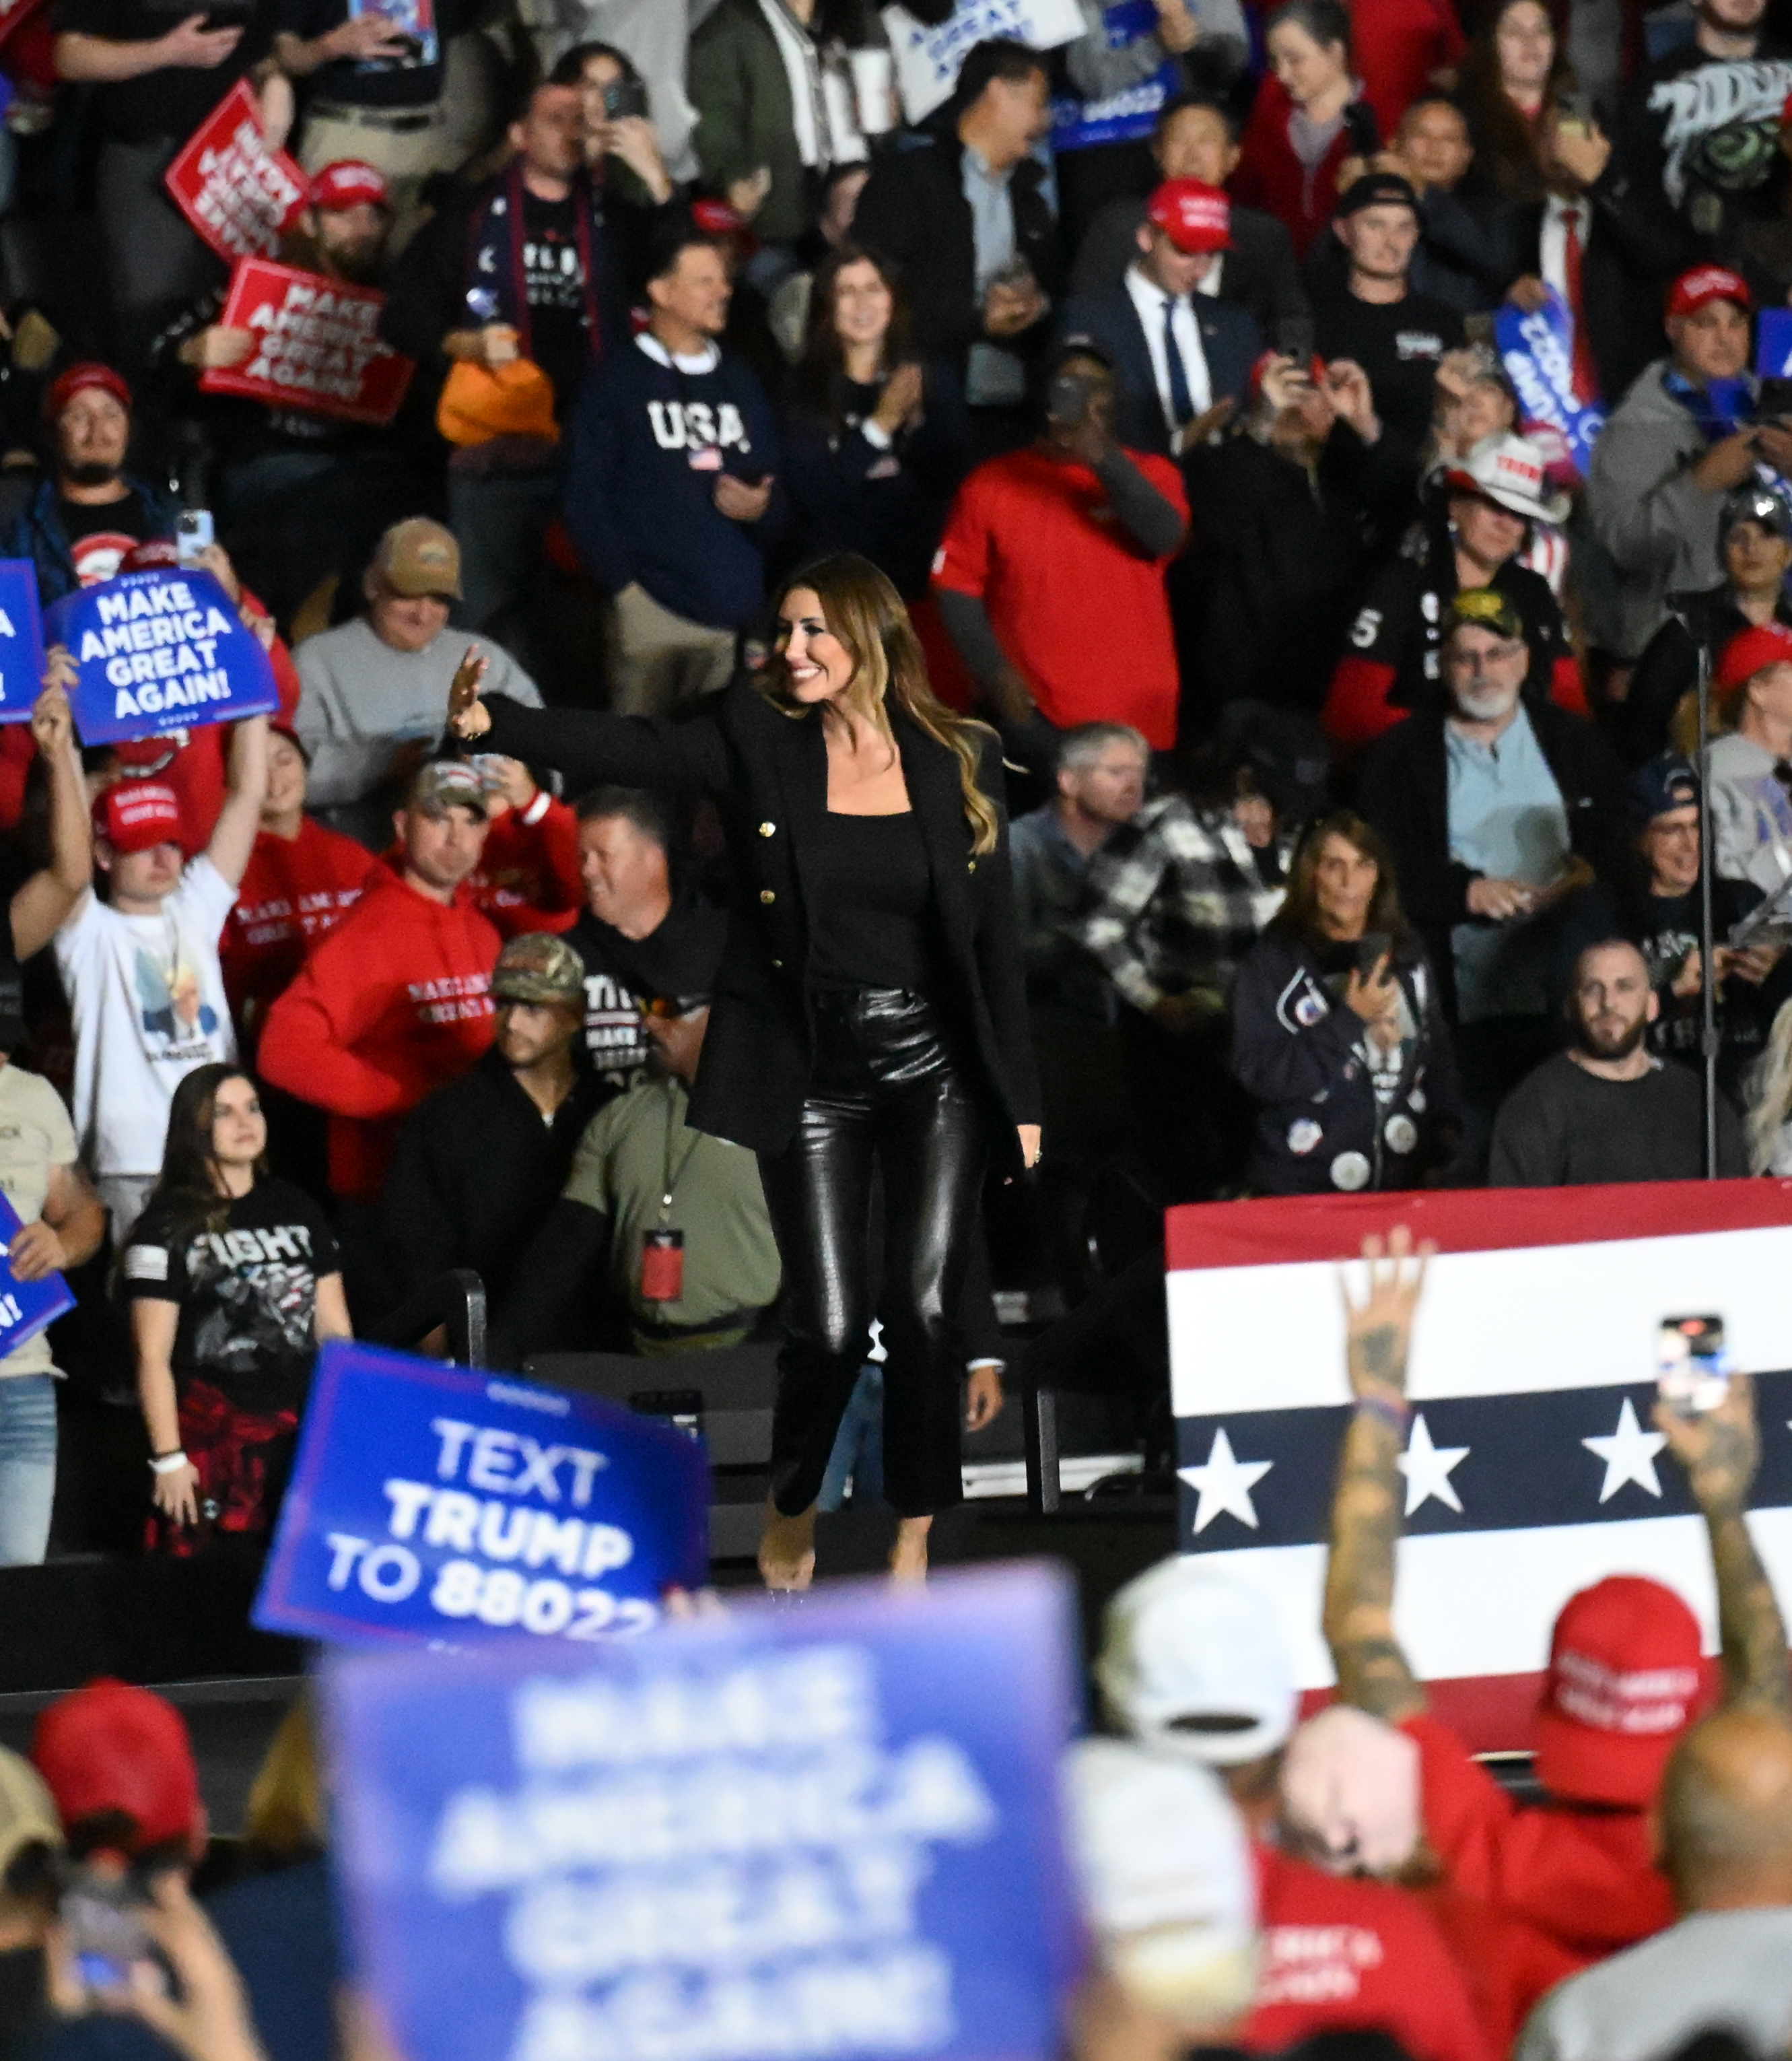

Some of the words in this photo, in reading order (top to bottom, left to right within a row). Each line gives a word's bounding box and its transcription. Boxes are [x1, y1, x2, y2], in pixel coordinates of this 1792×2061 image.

[648, 400, 751, 454] USA
[97, 581, 197, 626] MAKE
[1350, 607, 1383, 648] 5
[80, 608, 232, 663] AMERICA
[106, 641, 218, 687] GREAT
[115, 669, 232, 719] AGAIN!
[429, 1416, 610, 1508] TEXT
[384, 1479, 634, 1578] TRUMP
[326, 1532, 421, 1604] TO
[429, 1559, 659, 1642] 88022
